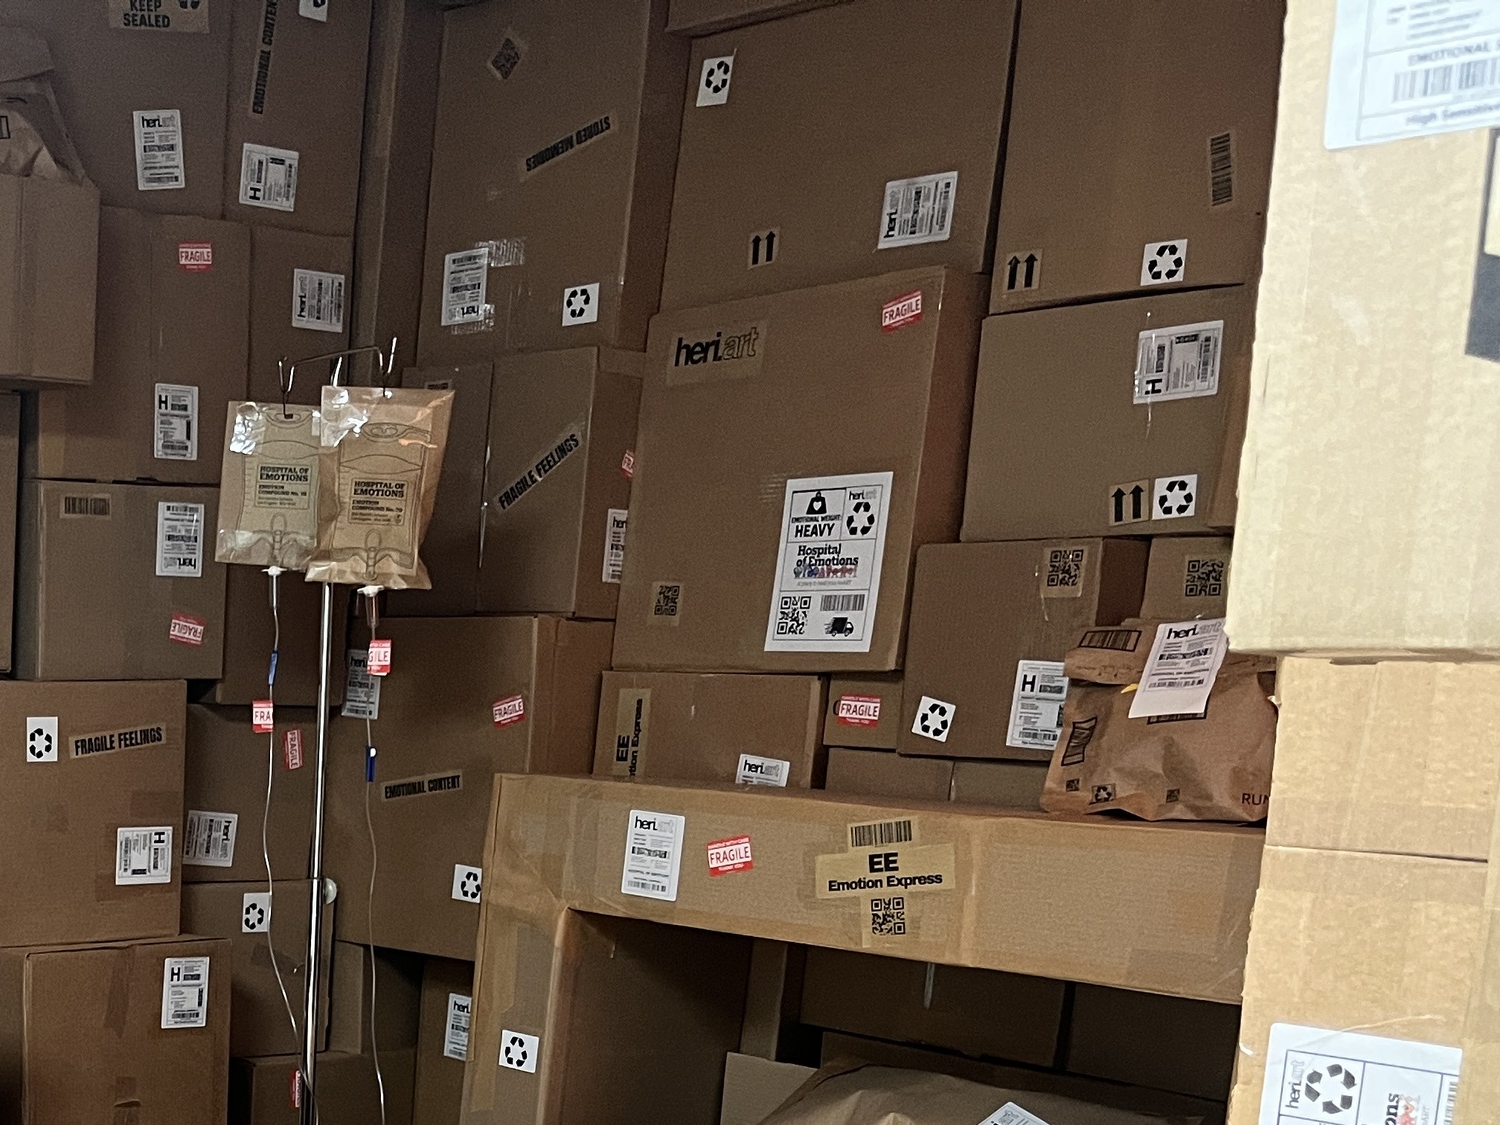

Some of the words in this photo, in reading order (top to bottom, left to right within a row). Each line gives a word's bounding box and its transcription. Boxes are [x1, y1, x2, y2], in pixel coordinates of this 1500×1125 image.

[123, 14, 170, 28] SEALED
[248, 187, 261, 200] H
[180, 249, 212, 263] FRAGILE
[882, 298, 921, 324] FRAGILE
[158, 395, 168, 410] H
[259, 466, 297, 475] HOSPITAL
[299, 467, 309, 475] OF
[259, 473, 308, 482] EMOTIONS
[498, 468, 536, 510] FRAGILE
[534, 433, 580, 479] FEELINGS
[353, 488, 404, 498] EMOTIONS
[354, 481, 391, 490] HOSPITAL
[794, 522, 835, 538] HEAVY
[798, 543, 842, 557] Hospital
[796, 558, 808, 568] of
[808, 556, 859, 567] Emotions
[171, 619, 202, 641] FRAGILE
[1021, 674, 1037, 692] H
[493, 701, 524, 722] FRAGILE
[840, 701, 879, 718] FRAGILE
[631, 698, 643, 746] Express
[74, 731, 114, 757] FRAGILE
[117, 726, 163, 749] FEELINGS
[289, 729, 299, 769] FRAGILE
[616, 735, 630, 762] EE
[384, 780, 427, 799] EMOTIONAL
[428, 775, 461, 793] CONTENT
[154, 832, 165, 845] H
[709, 846, 752, 867] FRAGILE
[868, 852, 899, 872] EE
[828, 876, 883, 892] Emotion
[886, 873, 943, 891] Express
[170, 967, 180, 982] H
